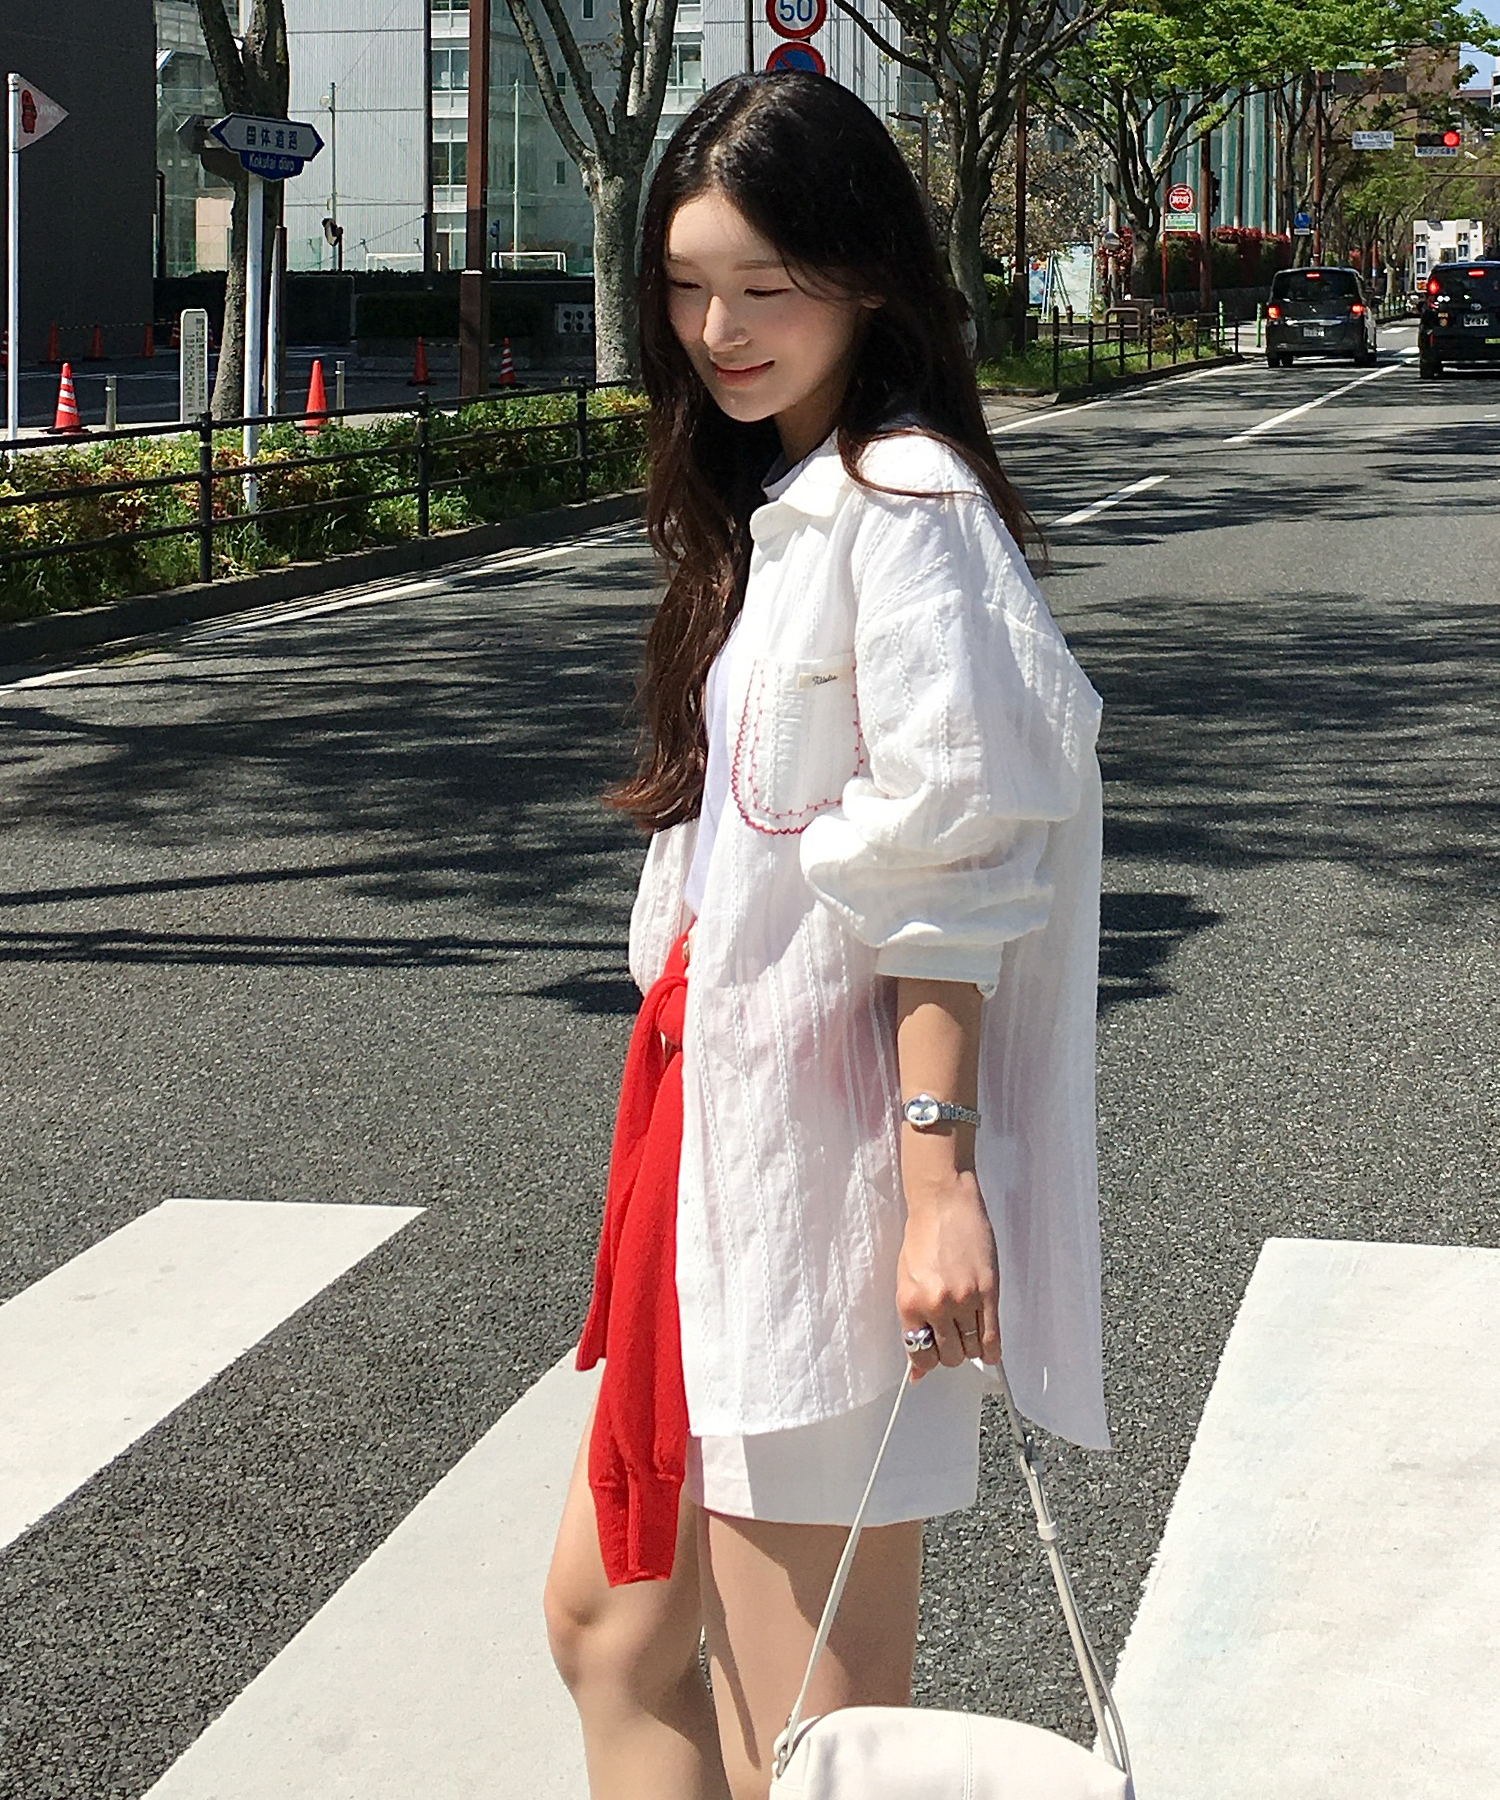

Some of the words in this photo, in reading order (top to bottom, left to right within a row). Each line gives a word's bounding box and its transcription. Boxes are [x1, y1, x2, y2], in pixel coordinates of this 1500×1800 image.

[780, 0, 812, 22] 50
[246, 125, 298, 151] 国体道路
